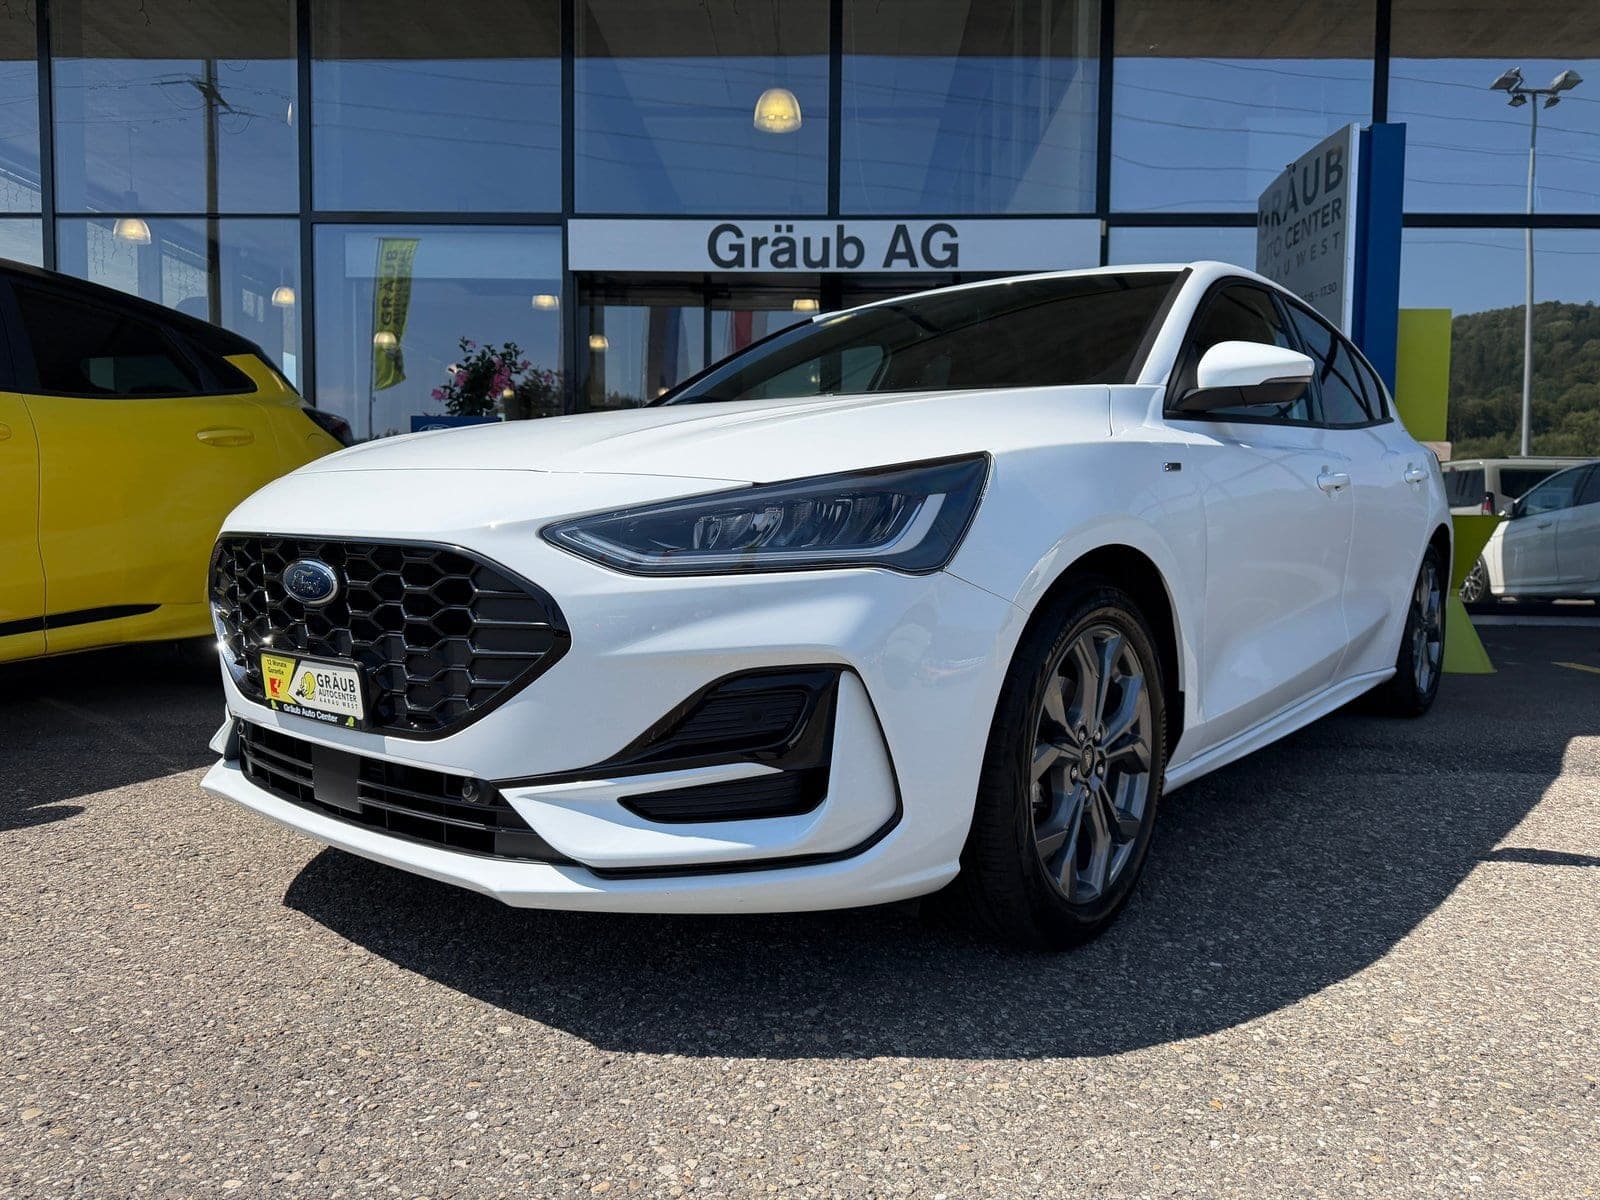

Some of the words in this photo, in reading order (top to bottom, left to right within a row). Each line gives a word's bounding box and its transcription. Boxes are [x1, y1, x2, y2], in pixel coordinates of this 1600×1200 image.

[1285, 198, 1343, 248] CENTER
[707, 223, 866, 269] Gräub
[882, 223, 959, 269] AG
[1297, 231, 1341, 268] WEST
[316, 671, 356, 693] GRÄUB
[318, 688, 358, 703] AUTOCENTER
[301, 706, 316, 718] Auto
[316, 710, 338, 723] Center
